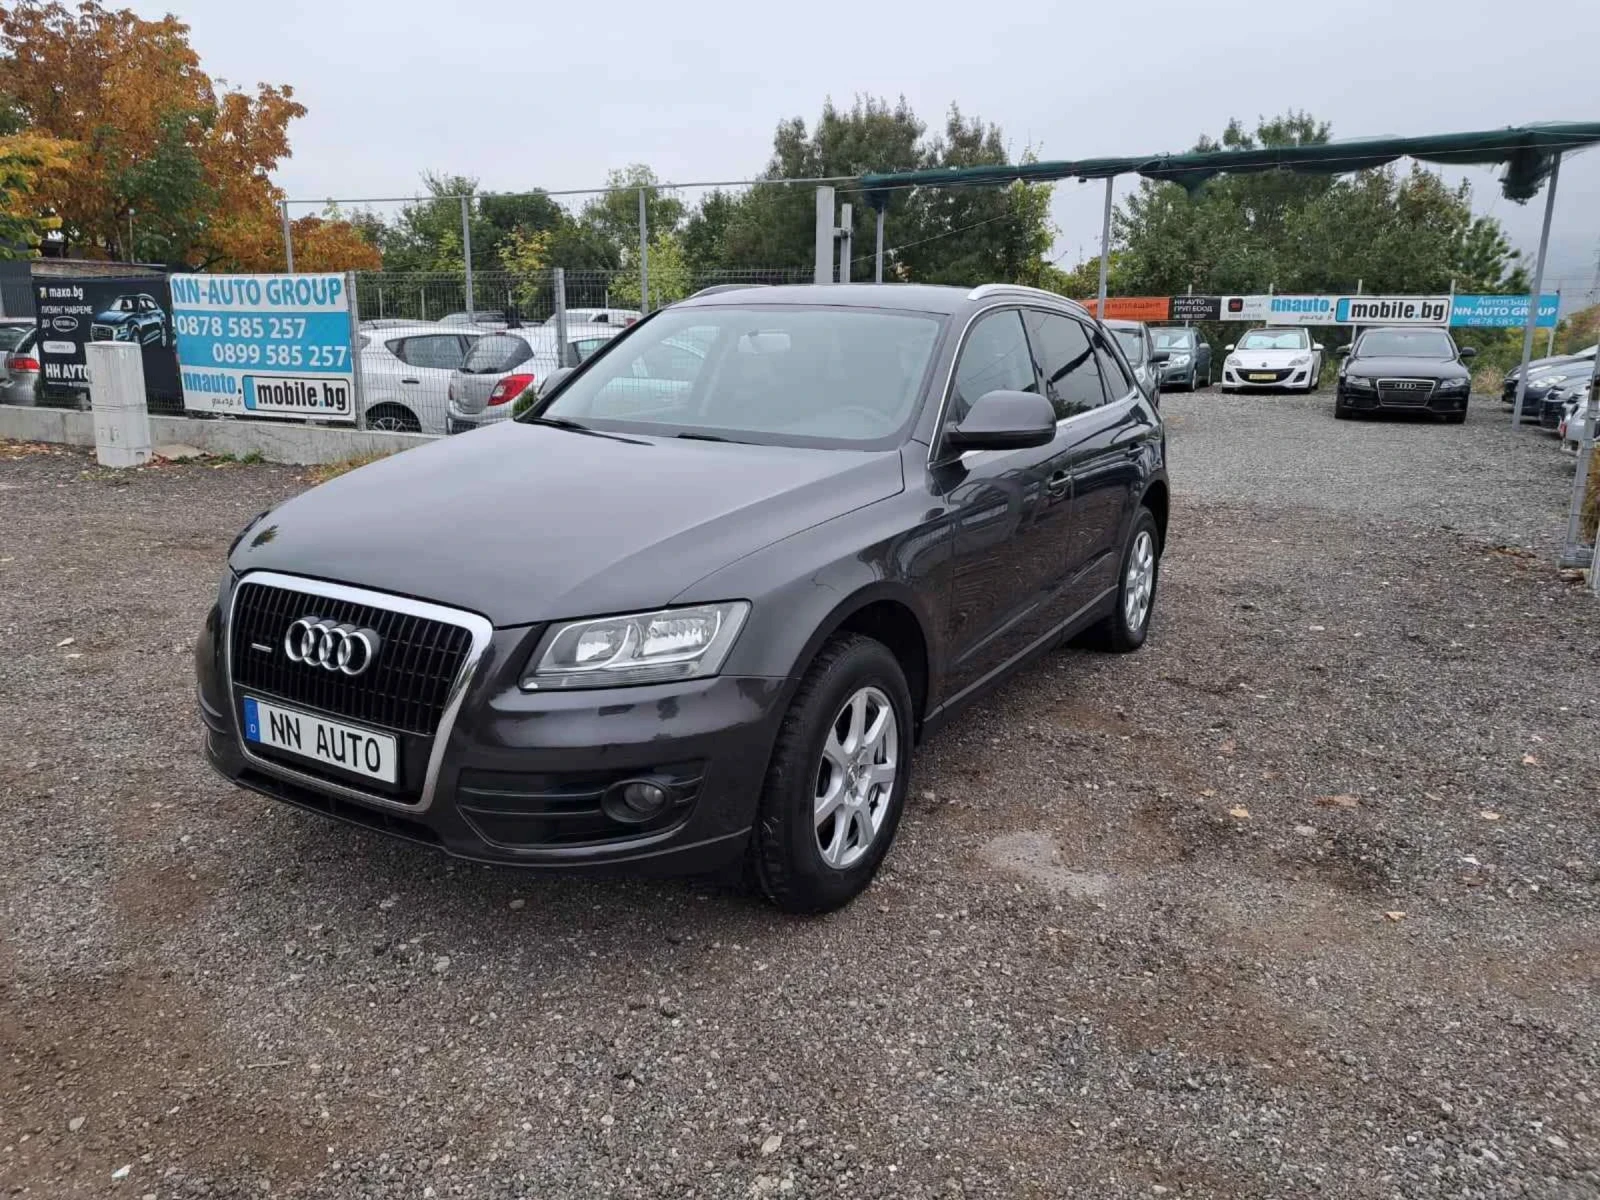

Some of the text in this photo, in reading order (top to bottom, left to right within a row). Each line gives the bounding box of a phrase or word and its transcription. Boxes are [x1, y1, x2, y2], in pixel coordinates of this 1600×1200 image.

[49, 285, 84, 300] maxo.bg
[172, 277, 342, 306] NN-AUTO GROUP
[1351, 301, 1445, 320] mobile.bg
[1453, 306, 1557, 316] NN-AUTO GRUP
[177, 315, 307, 339] 0878 585 257
[212, 342, 347, 367] 0899 585 257
[257, 380, 347, 411] mobile.bg
[250, 709, 381, 773] D NN AUTO
